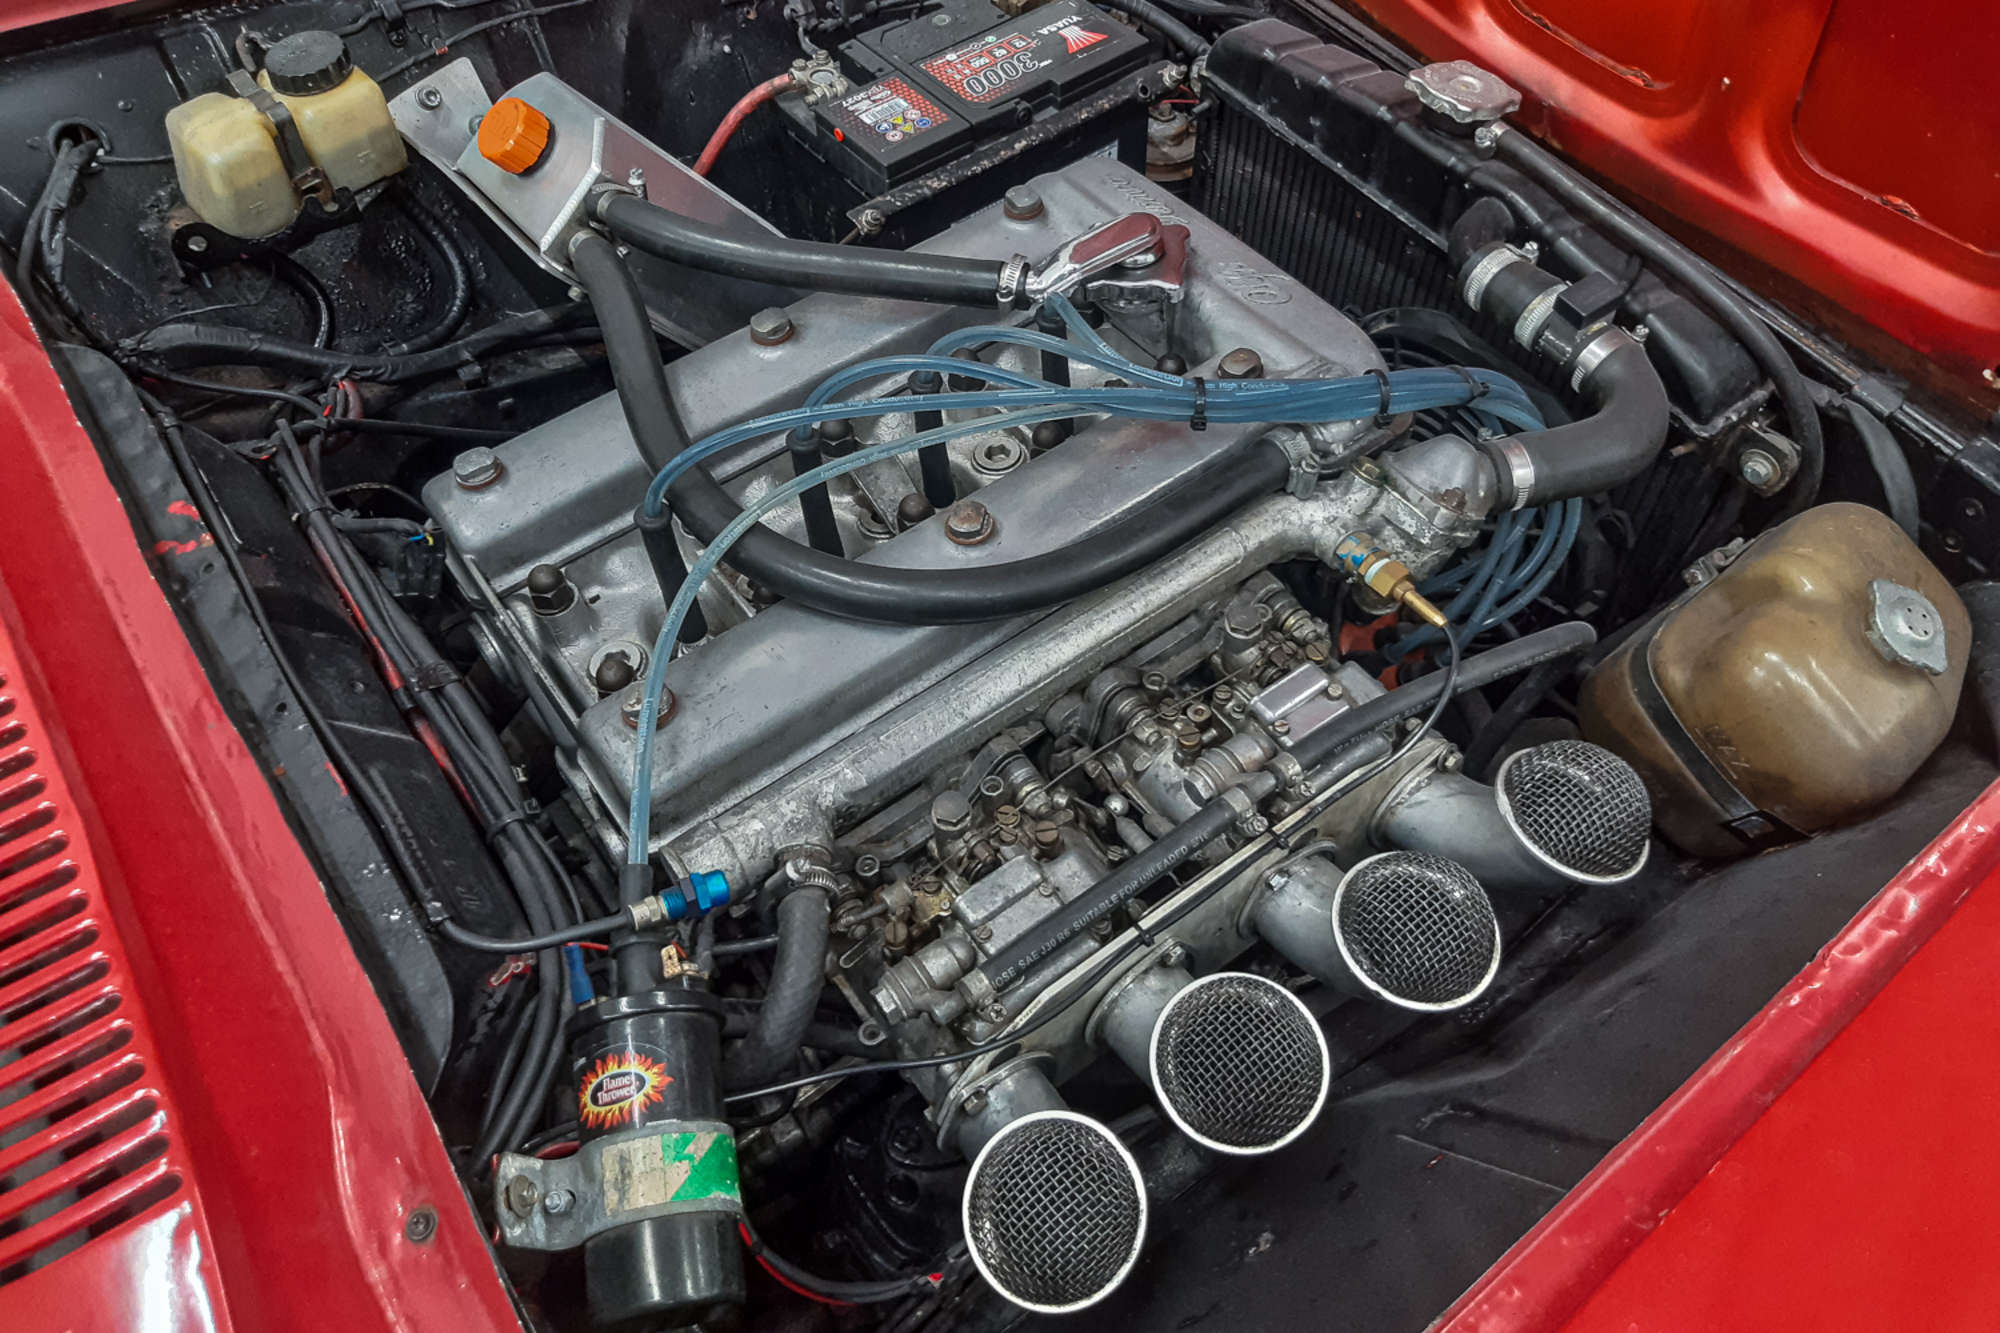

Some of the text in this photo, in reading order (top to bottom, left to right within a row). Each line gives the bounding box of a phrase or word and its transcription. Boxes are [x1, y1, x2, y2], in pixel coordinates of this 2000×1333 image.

[1037, 15, 1083, 35] YUASA
[963, 51, 1039, 96] 3000
[1017, 949, 1041, 969] SAE
[1072, 894, 1119, 932] SUITABLE
[1119, 879, 1139, 898] FOR
[1138, 845, 1188, 885] UNLEADED
